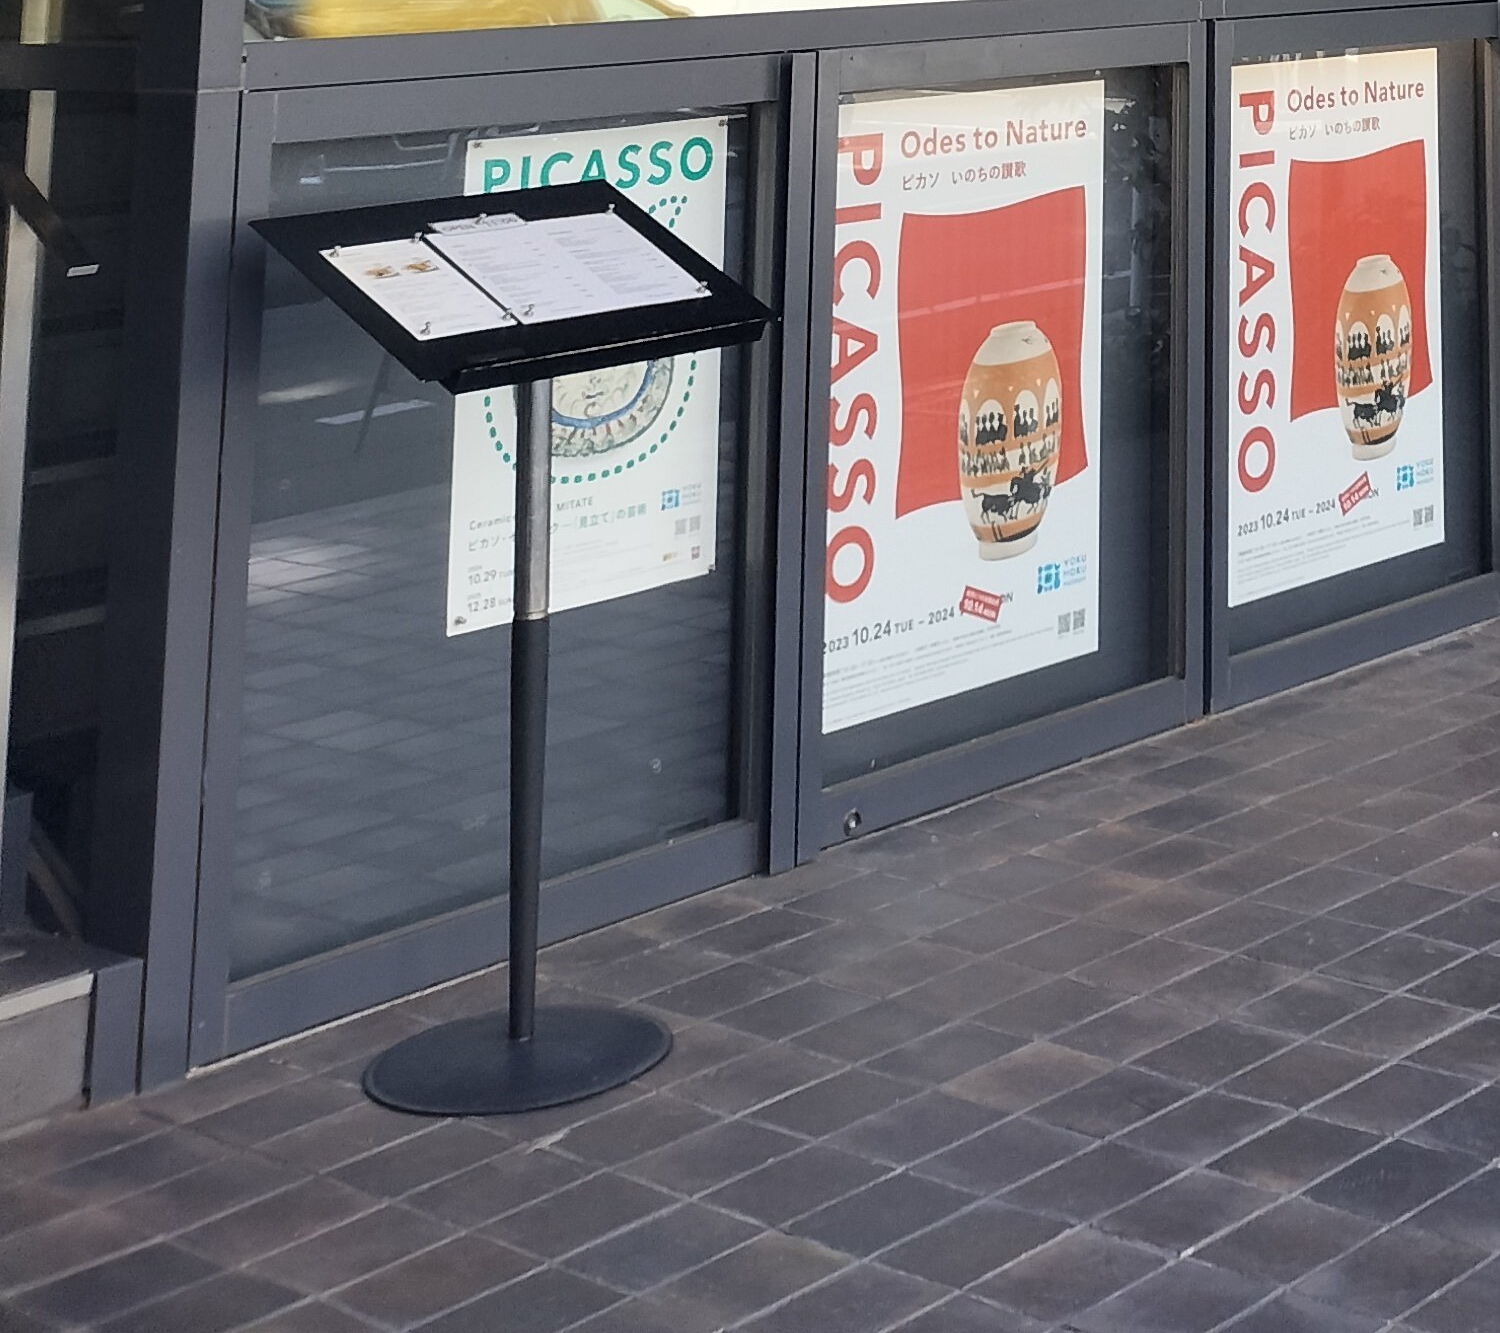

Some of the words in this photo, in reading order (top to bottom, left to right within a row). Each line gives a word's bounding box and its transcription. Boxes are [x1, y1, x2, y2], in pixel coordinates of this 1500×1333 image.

[1287, 85, 1335, 112] Odes
[1340, 86, 1359, 107] to
[1364, 80, 1425, 104] Nature
[901, 127, 966, 159] Odes
[973, 127, 999, 150] to
[1006, 119, 1087, 147] Nature
[1289, 124, 1317, 141] ピカソ
[483, 136, 714, 194] PICASSO
[902, 171, 940, 191] ピカソ
[1237, 90, 1276, 493] PICASSO
[825, 130, 884, 604] PICASSO
[556, 495, 593, 512] MITATE
[1237, 519, 1259, 537] 2023
[1260, 507, 1290, 531] 10.24
[1291, 507, 1306, 521] TUE
[1315, 497, 1336, 515] 2024
[823, 635, 849, 654] 2023
[852, 620, 891, 647] 10.24
[894, 619, 914, 635] TUE
[928, 606, 955, 625] 2024
